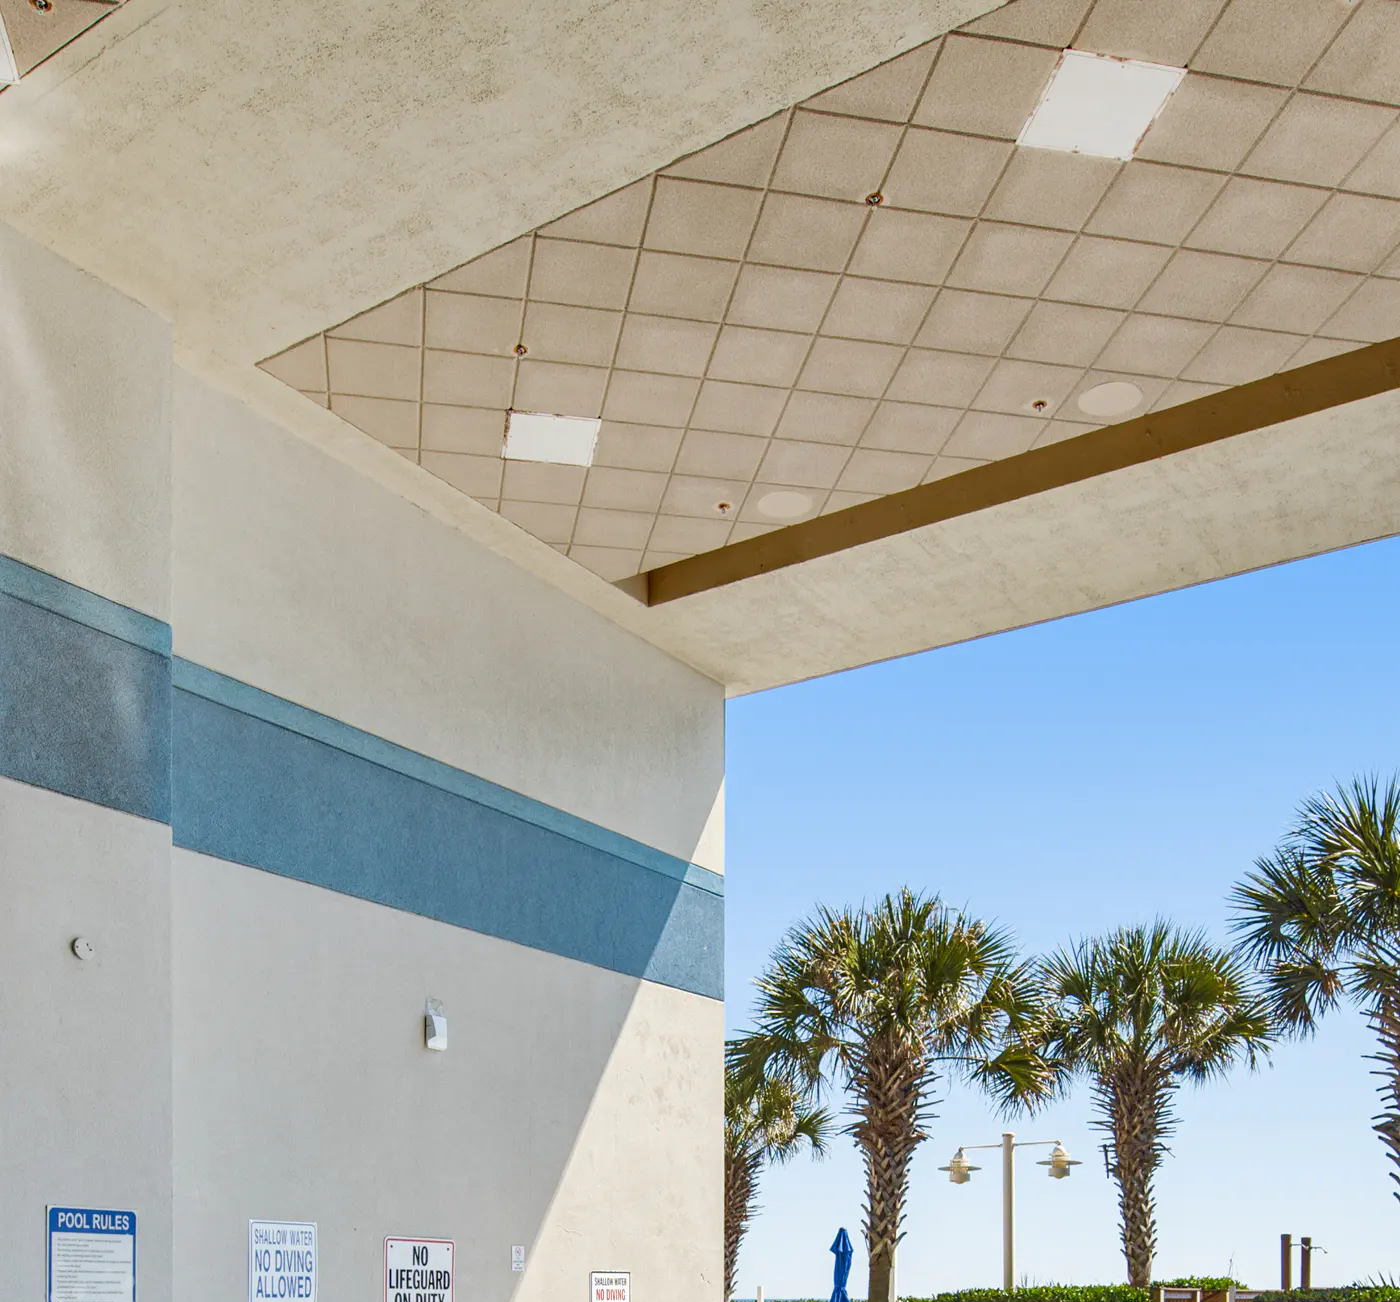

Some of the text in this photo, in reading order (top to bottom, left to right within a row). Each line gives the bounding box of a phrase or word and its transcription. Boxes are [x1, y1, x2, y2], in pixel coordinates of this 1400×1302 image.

[58, 1212, 130, 1230] POOL RULES
[254, 1228, 312, 1246] SHALLOW WATER
[255, 1249, 312, 1273] NO DIVING
[413, 1245, 428, 1266] NO
[256, 1275, 312, 1298] ALLOWED
[389, 1268, 451, 1290] LIFEGUARD
[594, 1277, 627, 1286] SHALLOW WATER
[596, 1288, 626, 1301] NO DIVING
